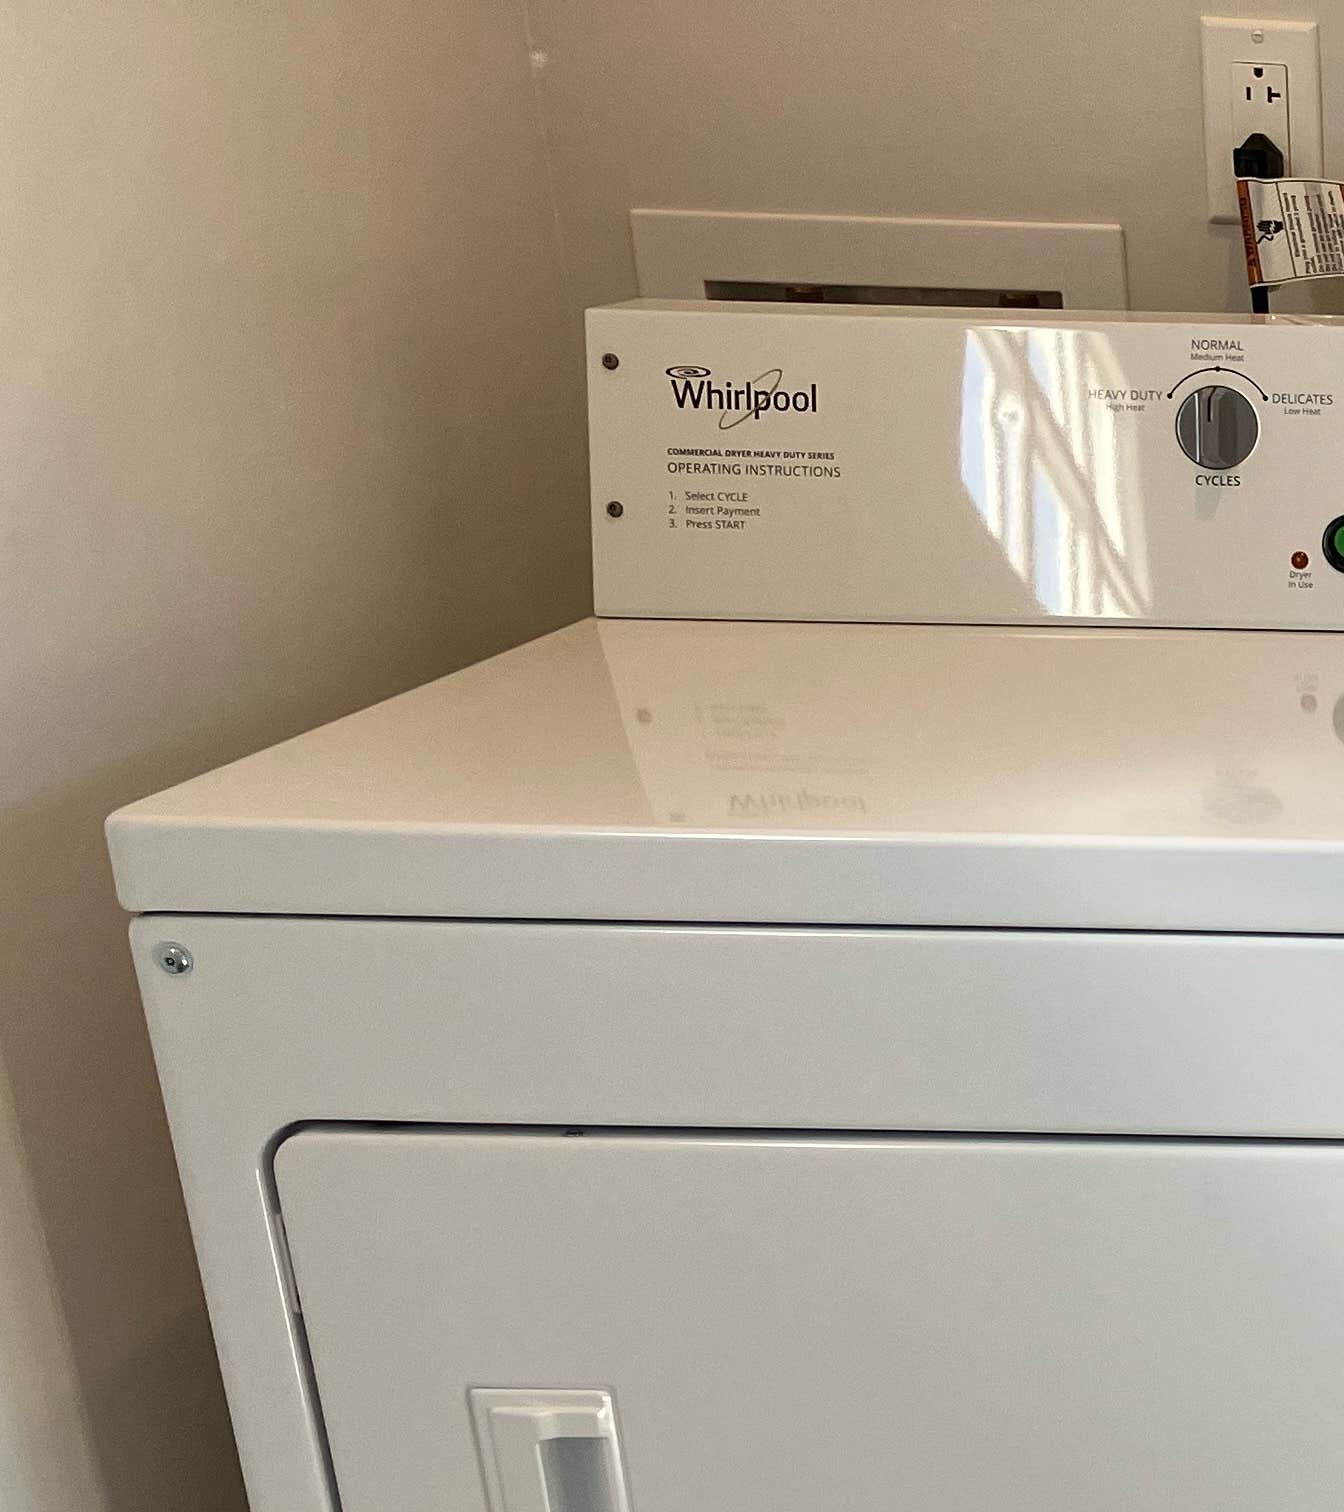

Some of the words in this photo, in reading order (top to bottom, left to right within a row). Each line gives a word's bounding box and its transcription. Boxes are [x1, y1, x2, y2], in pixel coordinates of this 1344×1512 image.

[1191, 339, 1243, 351] NORMAL
[1191, 353, 1218, 361] Medium
[1221, 354, 1244, 362] Heat
[671, 379, 817, 419] Whirlpool
[1089, 390, 1126, 401] HEAVY
[1130, 391, 1163, 401] DUTY
[1272, 393, 1333, 405] DELICATES
[1126, 404, 1145, 412] Heat
[1284, 407, 1299, 415] Low
[1302, 408, 1320, 416] Heat
[668, 448, 722, 457] COMMERCIAL
[725, 449, 752, 458] DRYER
[783, 451, 806, 459] DUTY
[668, 462, 741, 475] OPERATING
[746, 464, 840, 478] INSTRUCTIONS
[1195, 475, 1241, 487] CYCLES
[669, 491, 677, 500] 1.
[686, 491, 714, 501] Select
[718, 492, 748, 502] CYCLE
[669, 505, 677, 514] 2.
[686, 506, 714, 516] Insert
[718, 506, 760, 517] Payment
[669, 519, 678, 528] 3.
[686, 519, 712, 529] Press
[715, 520, 744, 529] START
[1289, 571, 1312, 580] Dryer
[1289, 581, 1296, 589] In
[1299, 581, 1313, 589] Use
